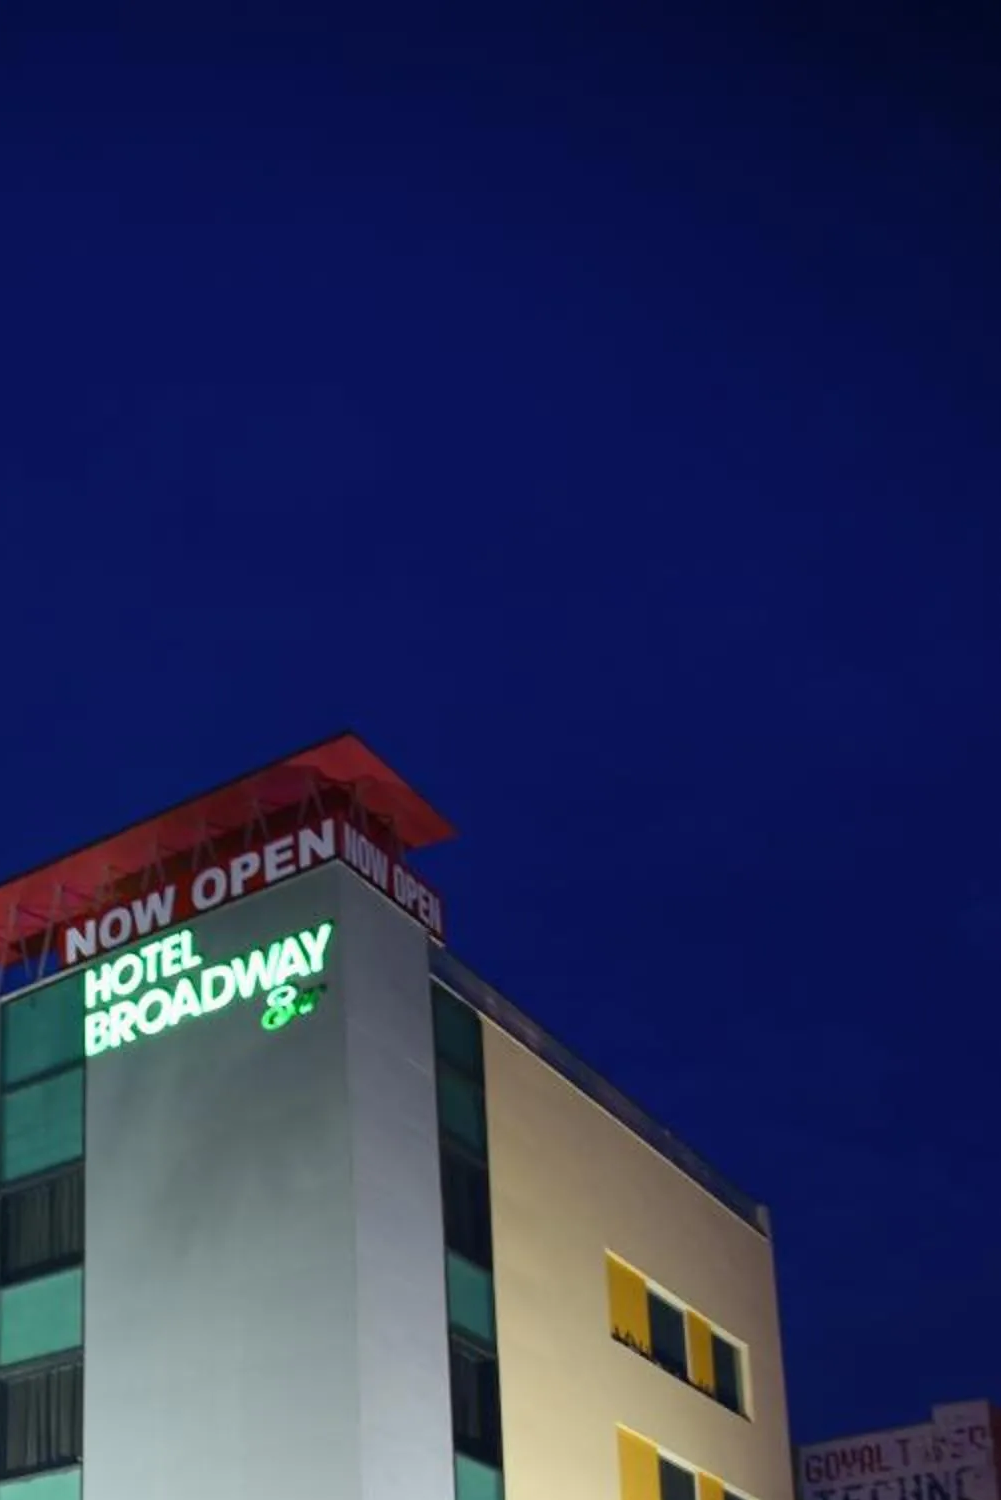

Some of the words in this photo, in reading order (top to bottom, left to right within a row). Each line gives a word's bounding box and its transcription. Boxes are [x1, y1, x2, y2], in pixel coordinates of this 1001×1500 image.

[65, 884, 177, 966] NOW
[190, 818, 336, 911] OPEN
[344, 822, 388, 888] NOW
[392, 862, 442, 938] OPEN
[84, 929, 203, 1009] HOTEL
[84, 921, 334, 1057] BROADWAY
[805, 1443, 894, 1483] GOYAL
